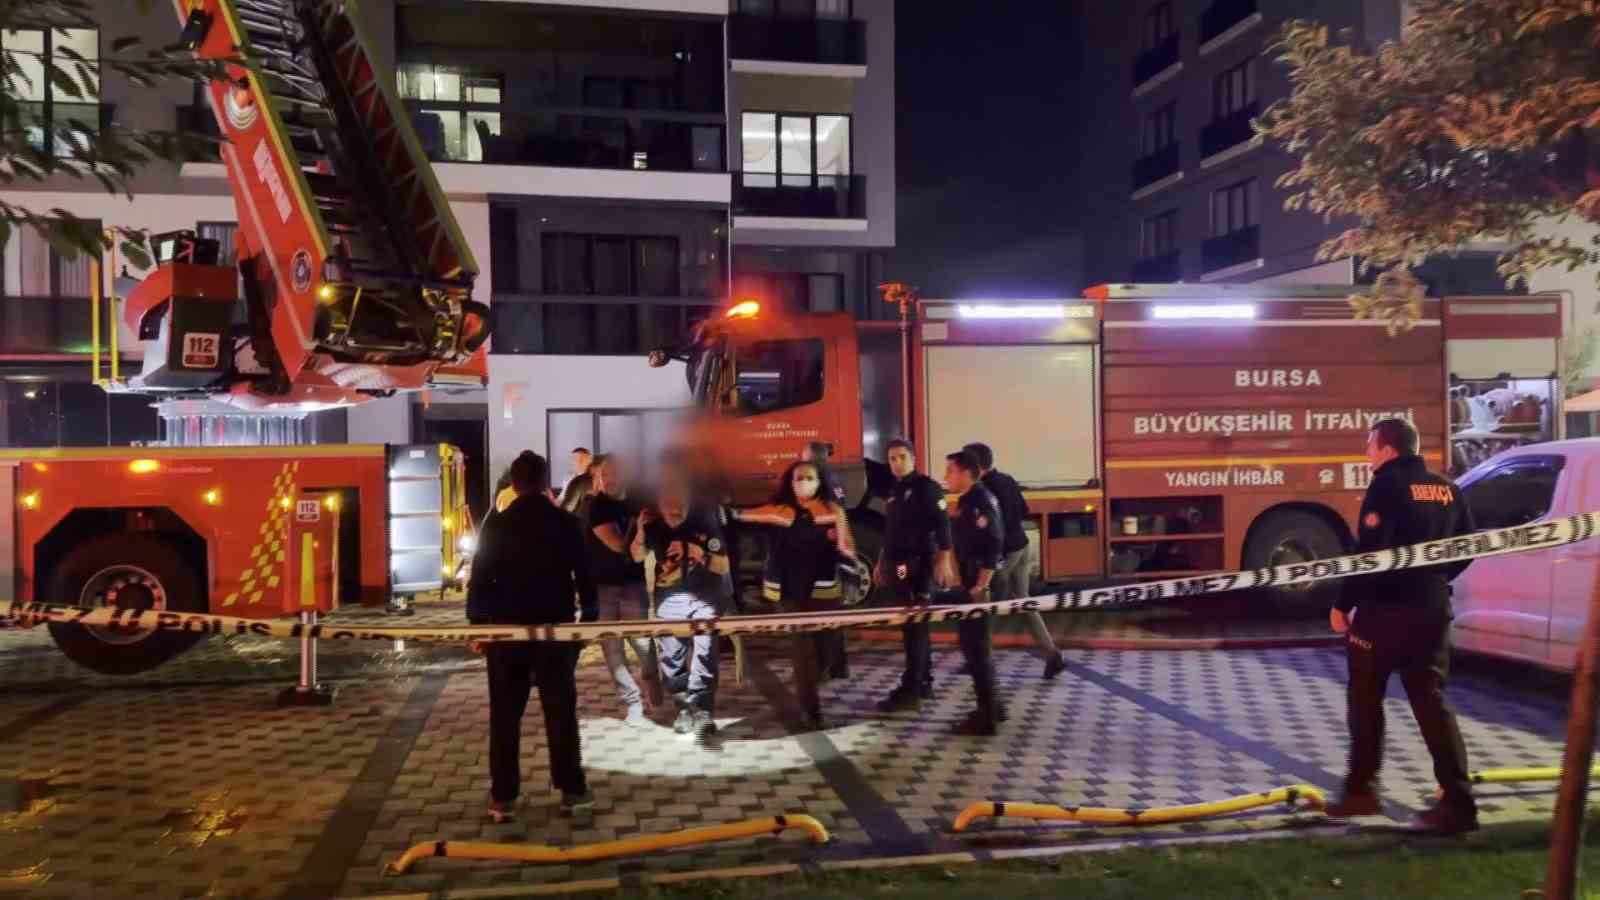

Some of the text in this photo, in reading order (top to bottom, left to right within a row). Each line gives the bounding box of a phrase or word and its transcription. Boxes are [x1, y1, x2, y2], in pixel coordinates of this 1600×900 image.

[190, 337, 213, 352] 112
[1235, 369, 1322, 387] BURSA
[1134, 410, 1294, 437] BÜYÜKŞEHİR
[1166, 470, 1228, 488] YANGIN
[301, 503, 316, 513] 112
